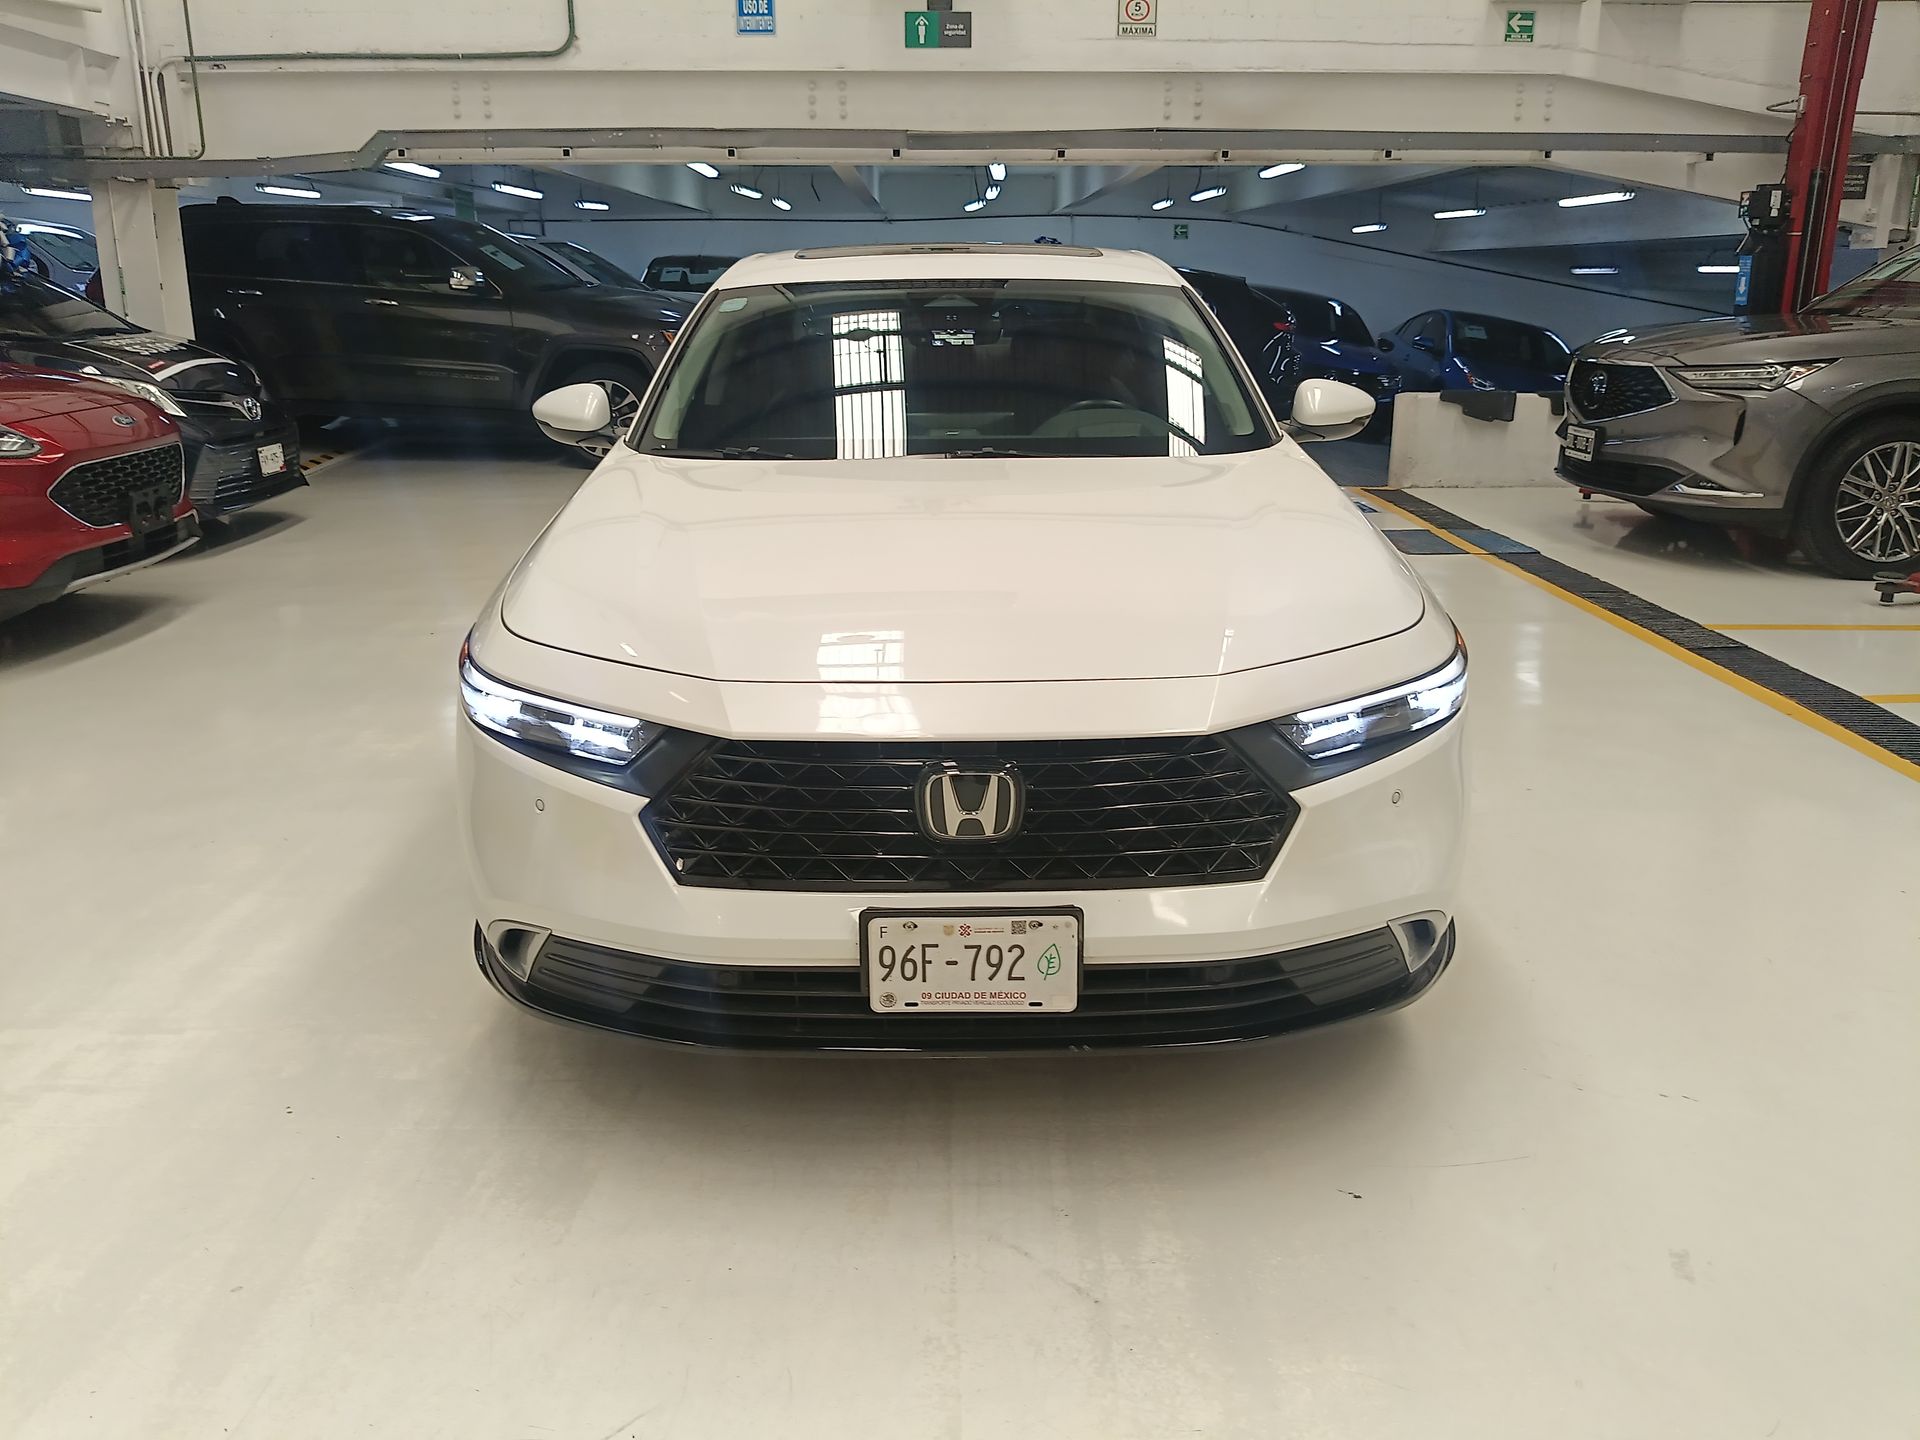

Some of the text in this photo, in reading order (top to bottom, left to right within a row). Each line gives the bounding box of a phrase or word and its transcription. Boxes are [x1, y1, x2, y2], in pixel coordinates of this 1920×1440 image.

[742, 0, 768, 14] USO DE
[1134, 1, 1142, 12] 5
[879, 926, 888, 938] F
[878, 944, 1025, 982] 96F-792
[989, 990, 1027, 999] MÉXICO
